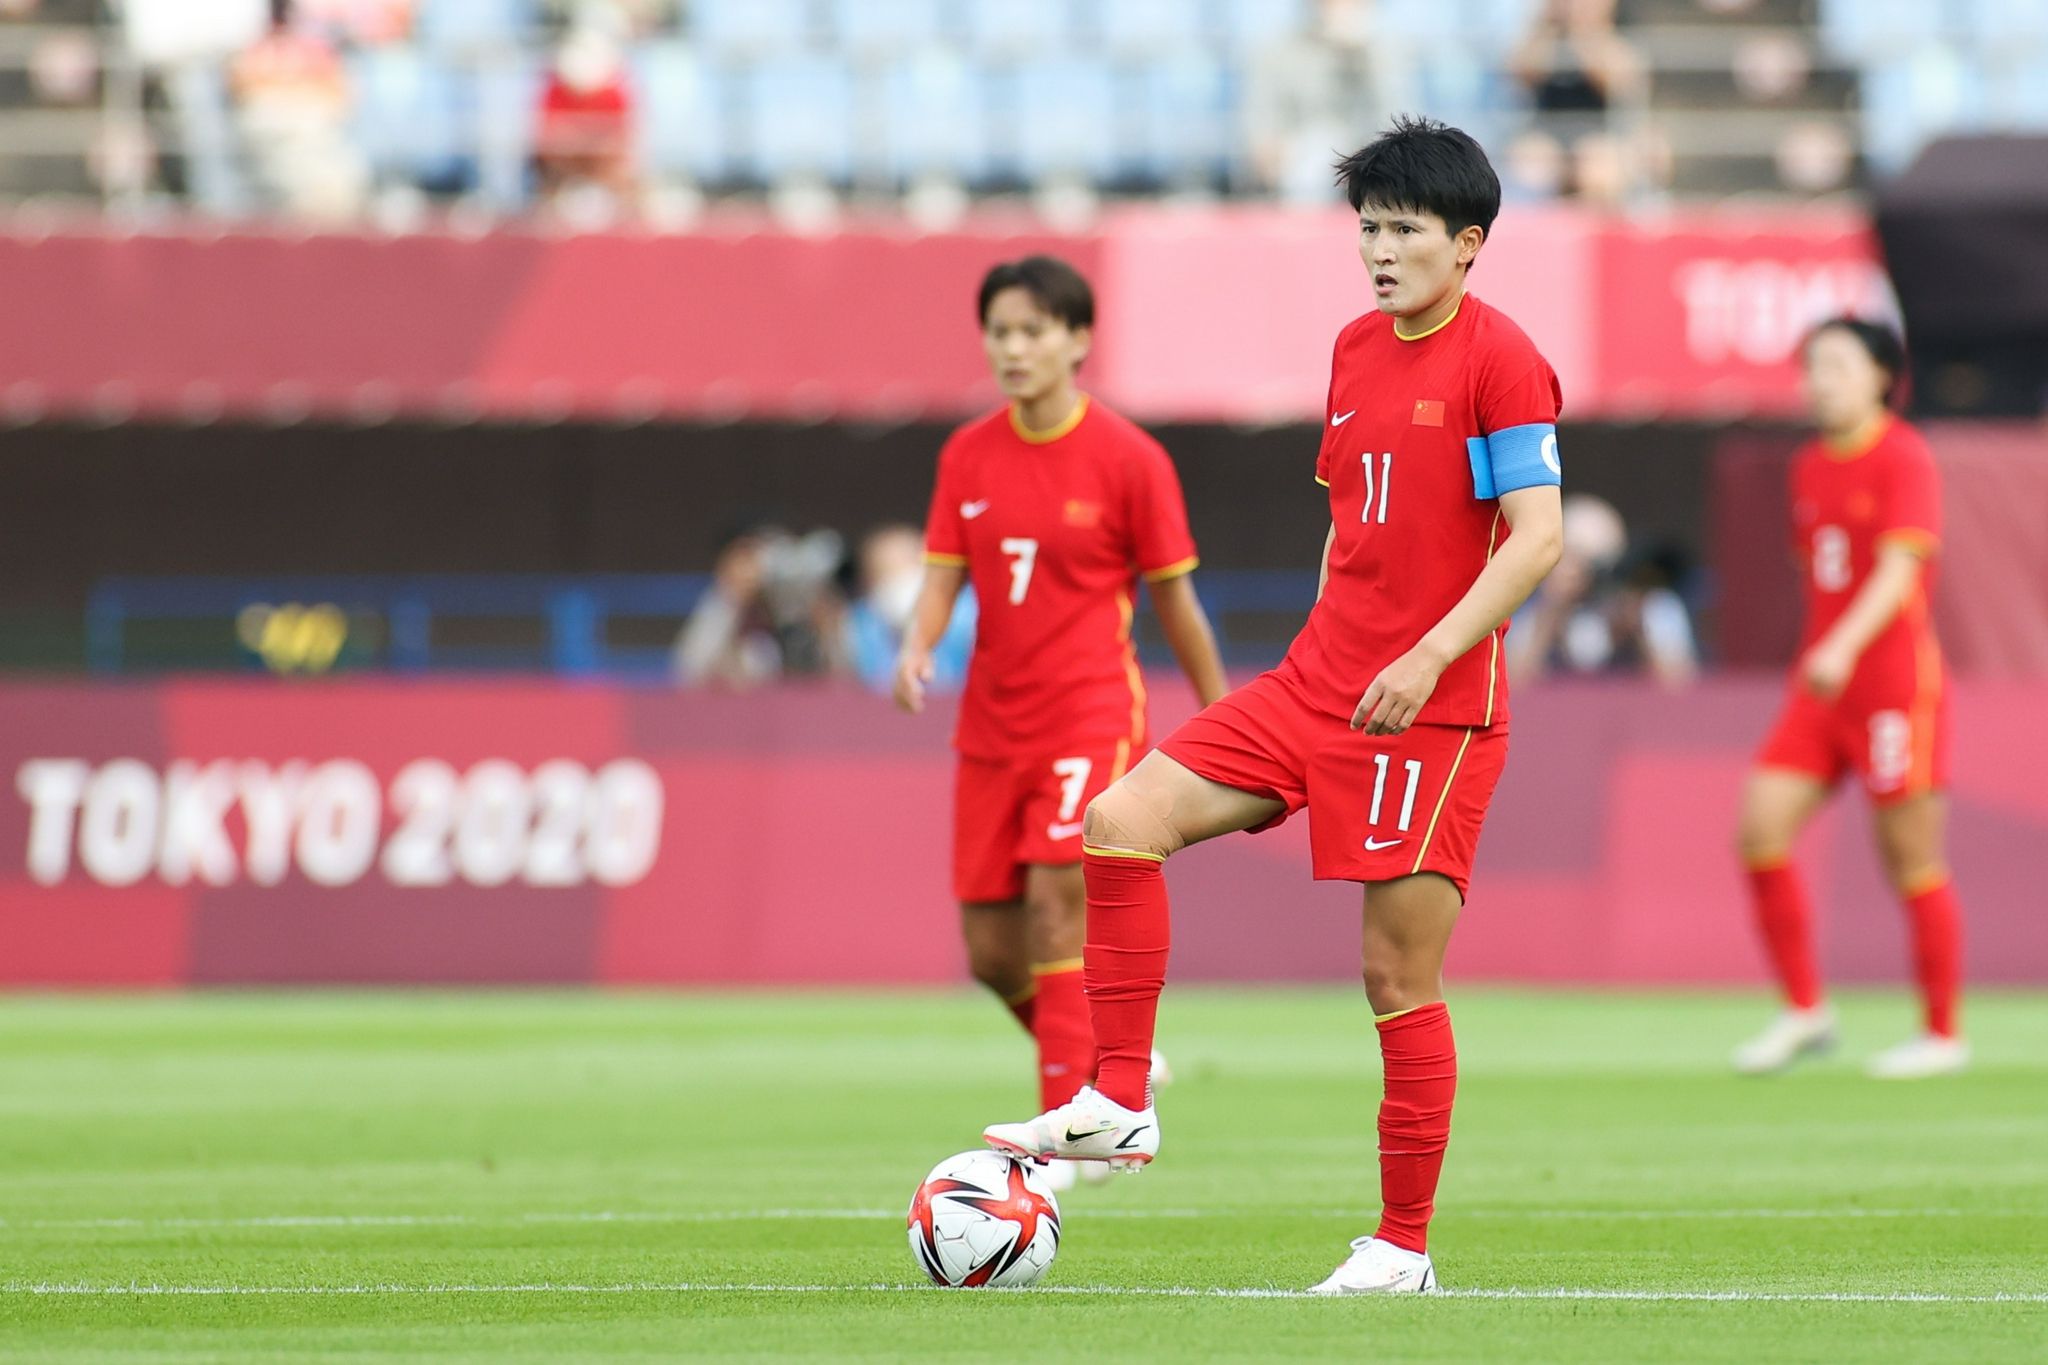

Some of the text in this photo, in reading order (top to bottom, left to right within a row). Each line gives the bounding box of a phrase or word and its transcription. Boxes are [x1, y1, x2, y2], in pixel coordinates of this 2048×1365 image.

[1361, 452, 1392, 524] 11
[1001, 537, 1038, 606] 7
[17, 757, 664, 887] TOKYO 2020
[1052, 756, 1093, 822] 7
[1368, 753, 1422, 832] 11
